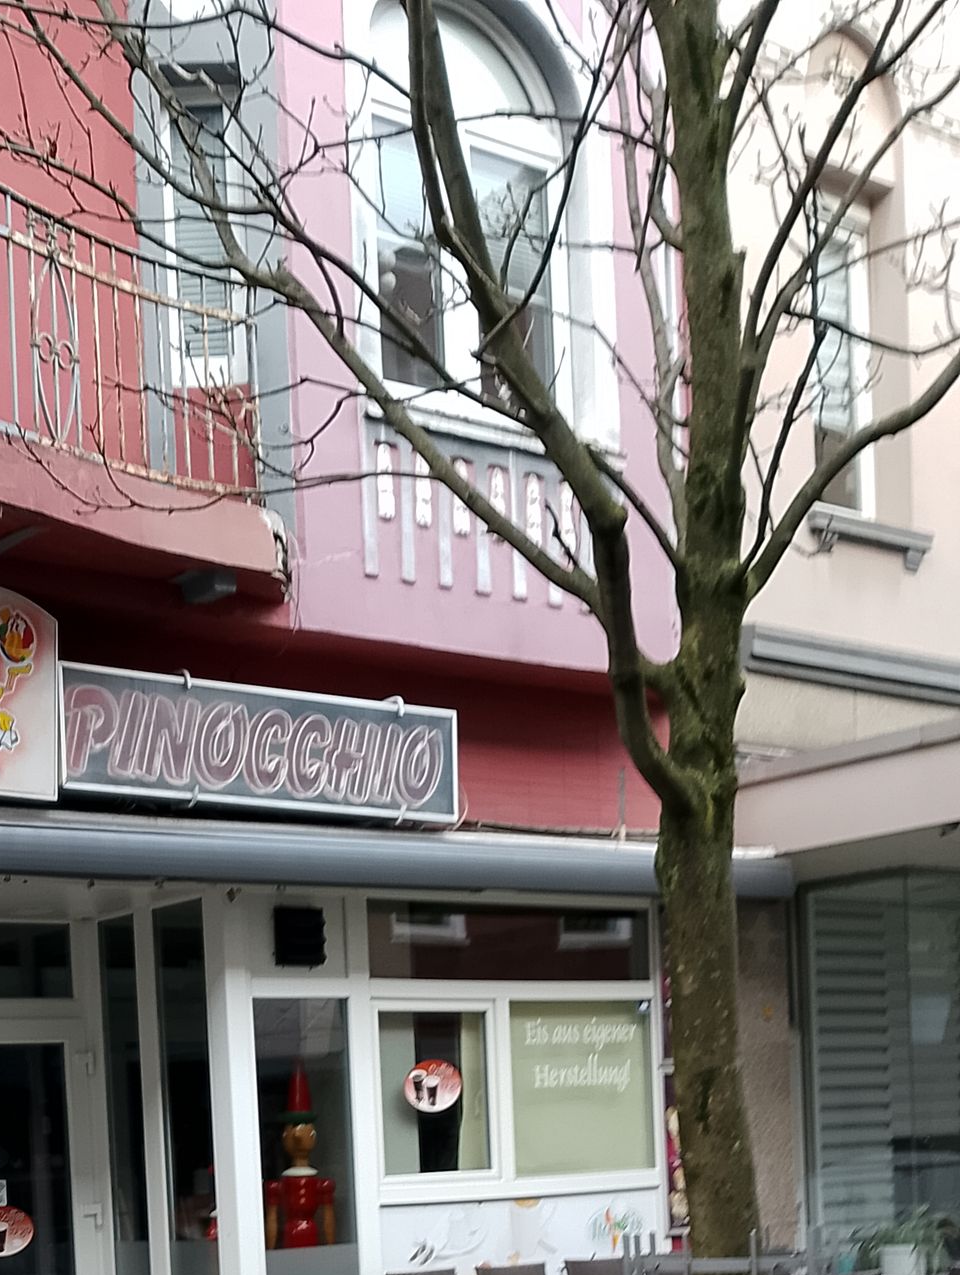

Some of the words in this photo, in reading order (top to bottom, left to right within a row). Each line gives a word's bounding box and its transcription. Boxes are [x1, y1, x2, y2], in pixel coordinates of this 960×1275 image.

[66, 684, 444, 808] PINOCCHIO
[524, 1017, 550, 1046] Eis
[551, 1023, 580, 1045] aus
[583, 1016, 637, 1051] eigener
